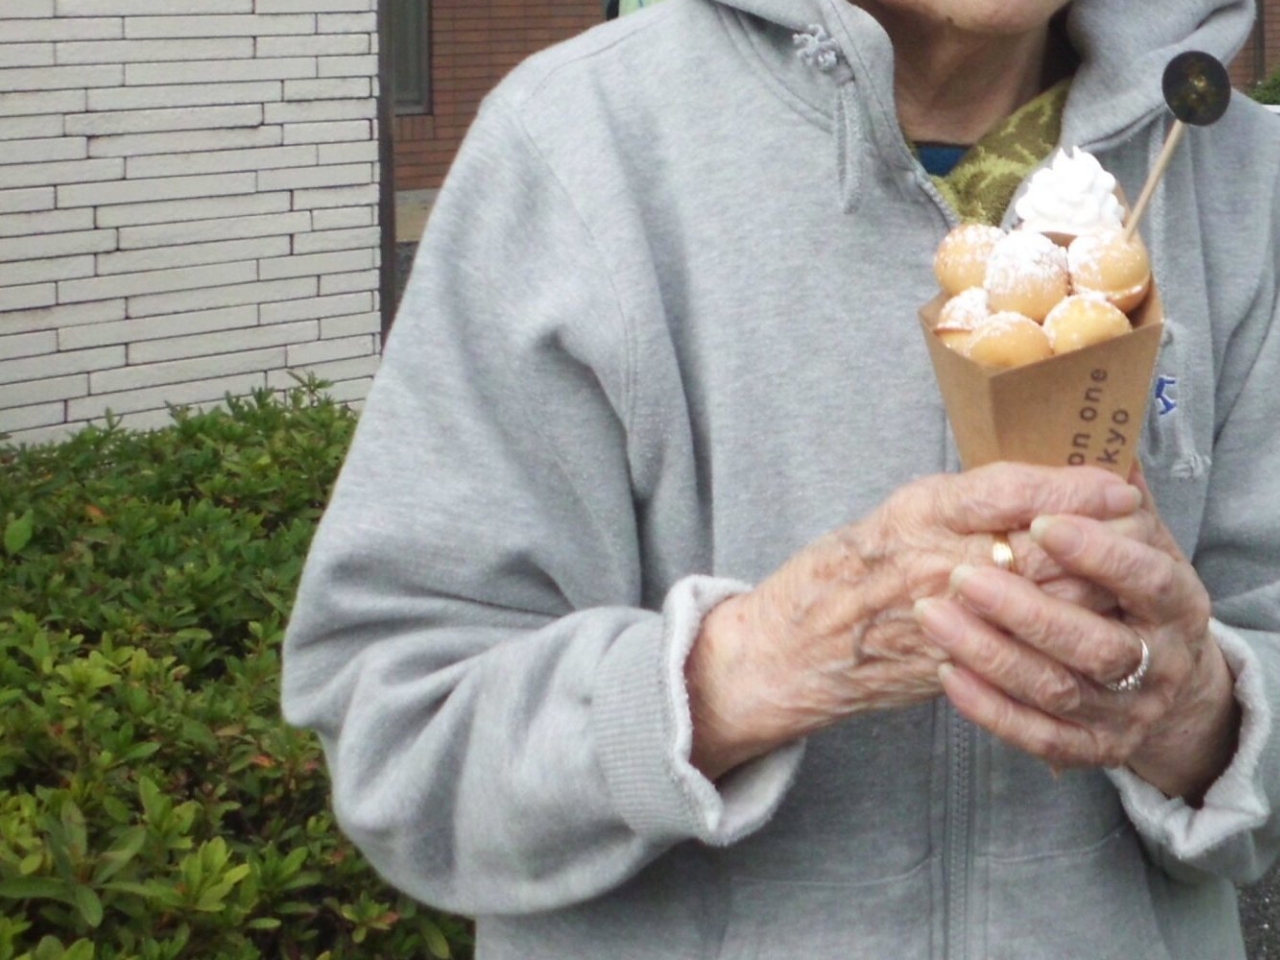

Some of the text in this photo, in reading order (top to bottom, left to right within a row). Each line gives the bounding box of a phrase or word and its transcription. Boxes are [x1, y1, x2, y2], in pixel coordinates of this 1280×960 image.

[1067, 368, 1107, 467] on one
[1095, 409, 1129, 464] kyo
